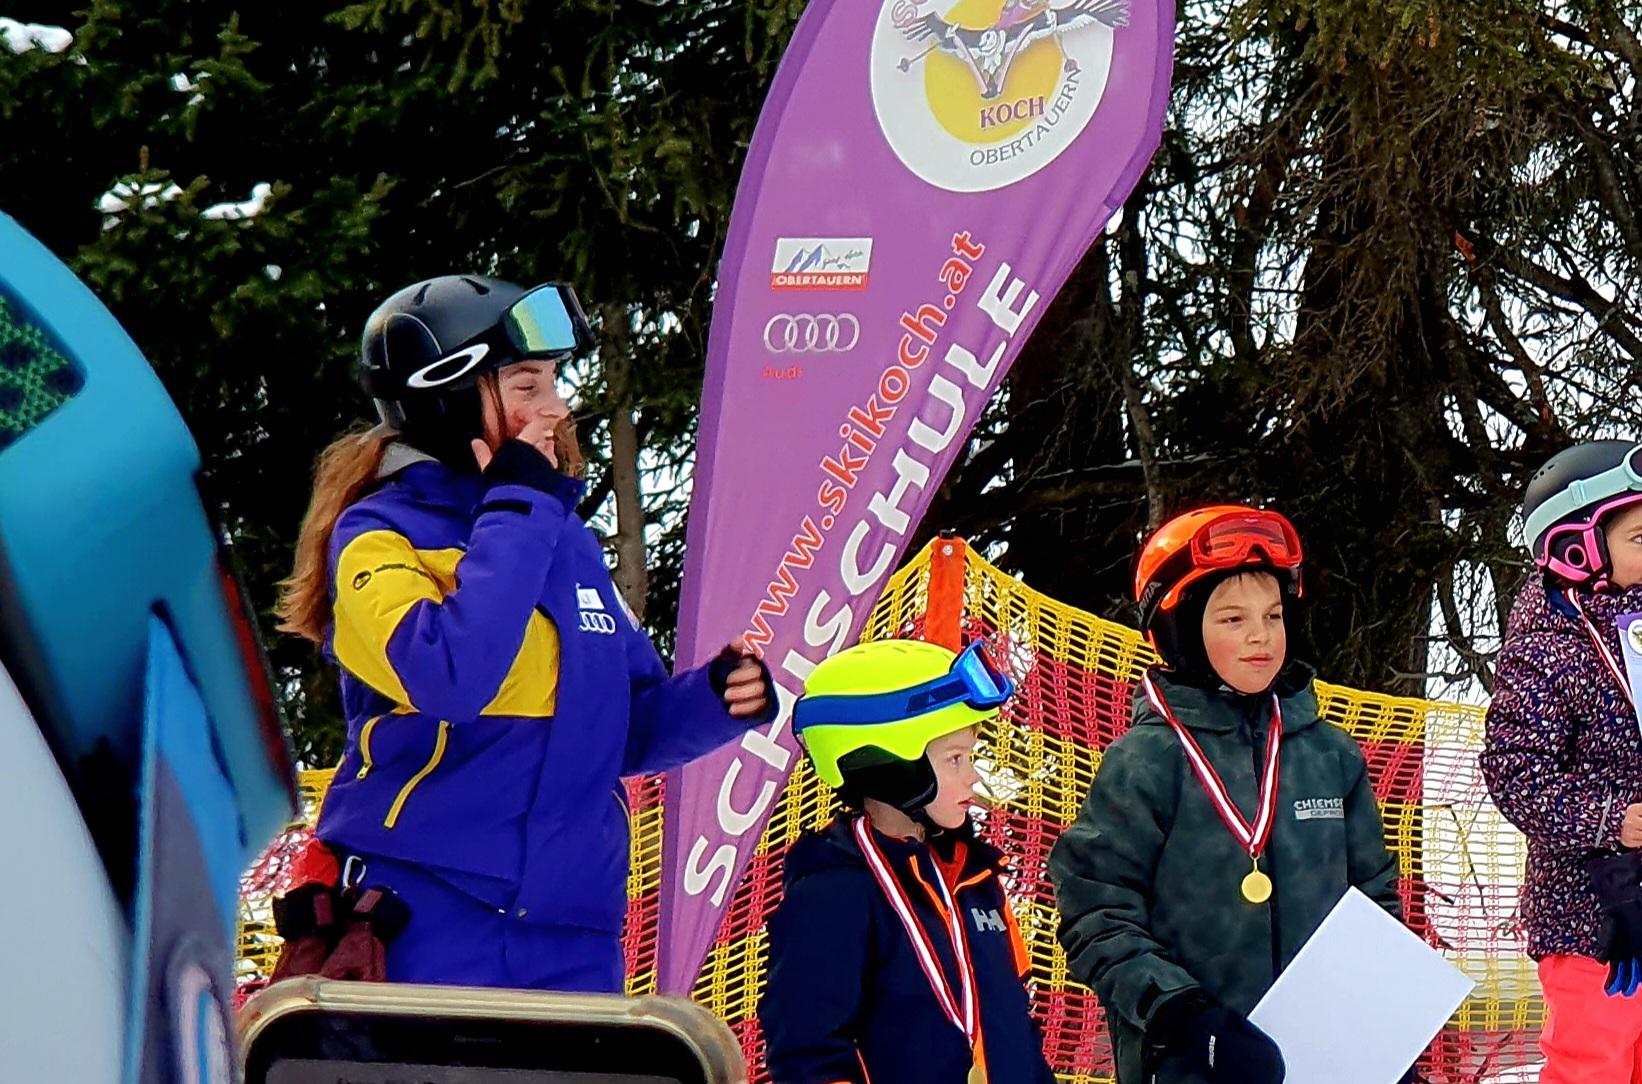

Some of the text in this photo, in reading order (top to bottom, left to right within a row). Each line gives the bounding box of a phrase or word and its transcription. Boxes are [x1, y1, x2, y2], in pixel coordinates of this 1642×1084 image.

[970, 66, 1082, 166] OBERTAUERN
[979, 95, 1046, 129] KOCH
[775, 275, 862, 286] OBERTAUERN
[741, 229, 986, 659] www.skikoch.at
[684, 261, 1040, 908] SCHISCHULE
